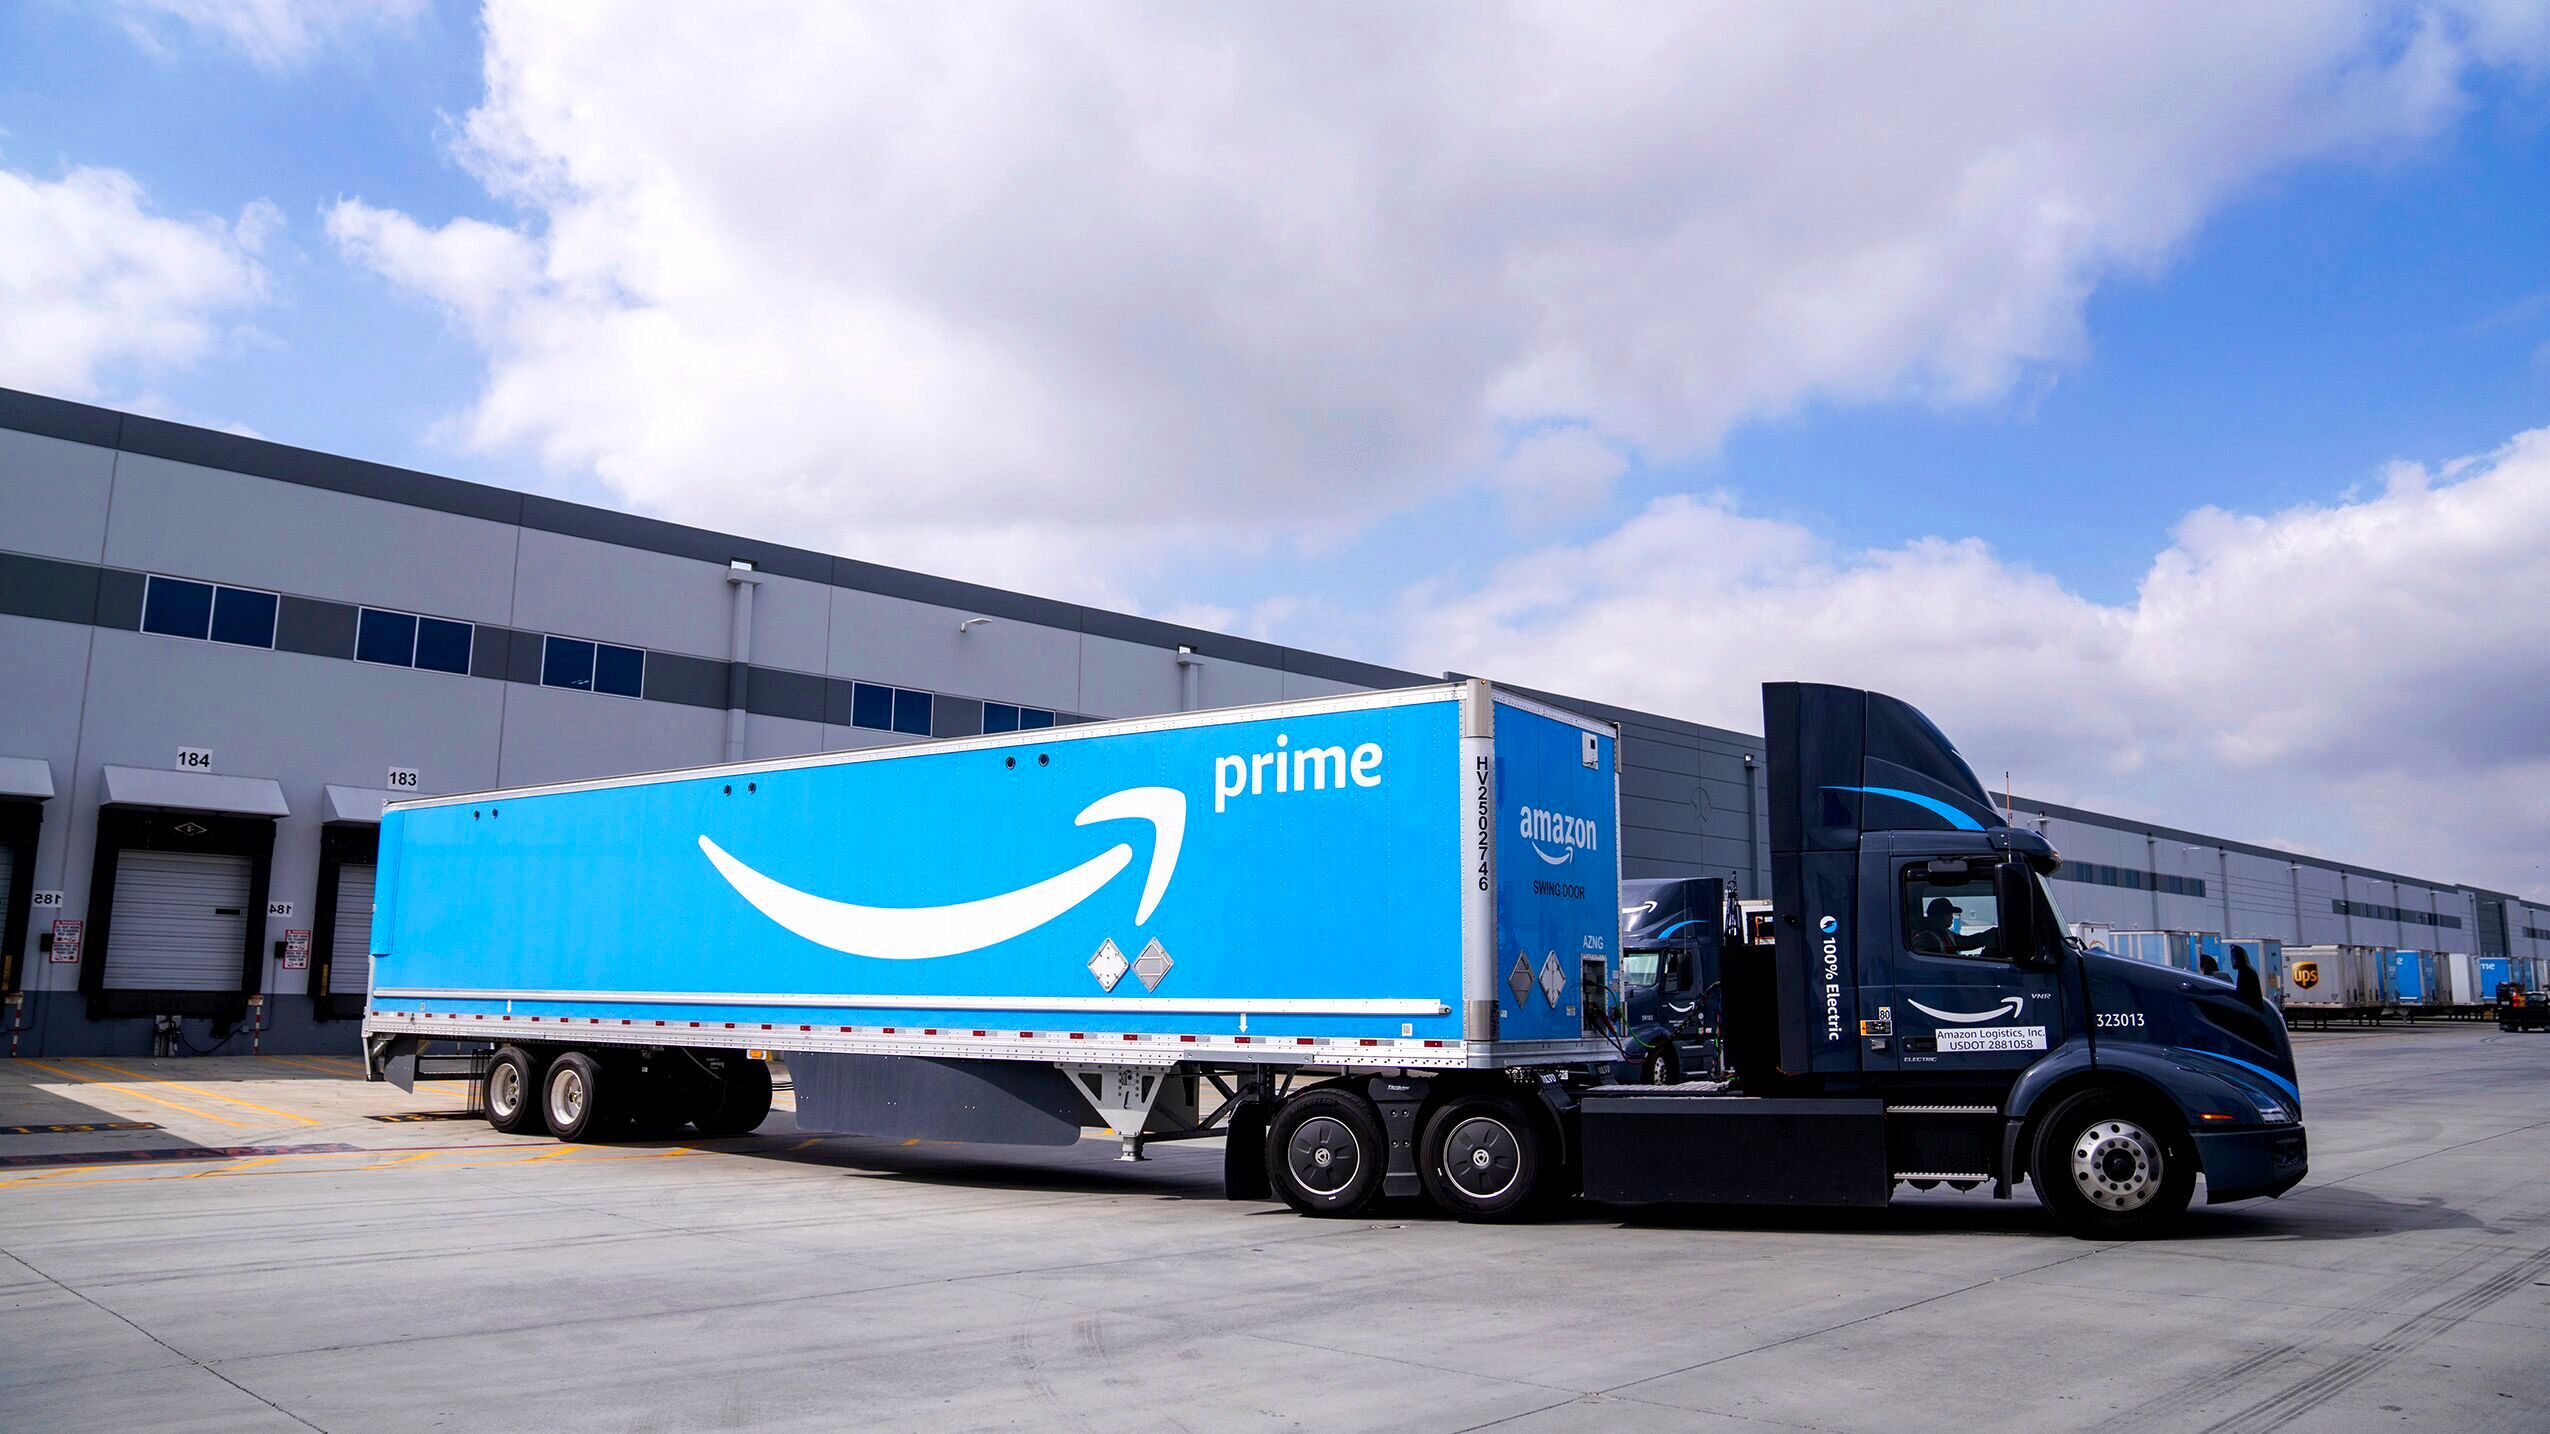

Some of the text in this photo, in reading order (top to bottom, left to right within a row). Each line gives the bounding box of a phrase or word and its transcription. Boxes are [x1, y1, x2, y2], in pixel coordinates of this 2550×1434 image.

[178, 751, 210, 767] 184
[390, 771, 417, 786] 183
[1215, 734, 1383, 813] prime
[1476, 756, 1489, 891] HV2502746
[1520, 806, 1597, 851] amazon
[1533, 880, 1585, 899] SWING DOOR
[1583, 935, 1604, 949] AZNG
[2294, 969, 2318, 986] ups
[1823, 937, 1842, 1041] 100% Electric
[1880, 1010, 1891, 1020] 80
[2096, 1013, 2145, 1027] 323013
[1937, 1028, 2046, 1040] Amazon Logistics, Inc.
[1950, 1040, 2034, 1051] USDOT 2881058
